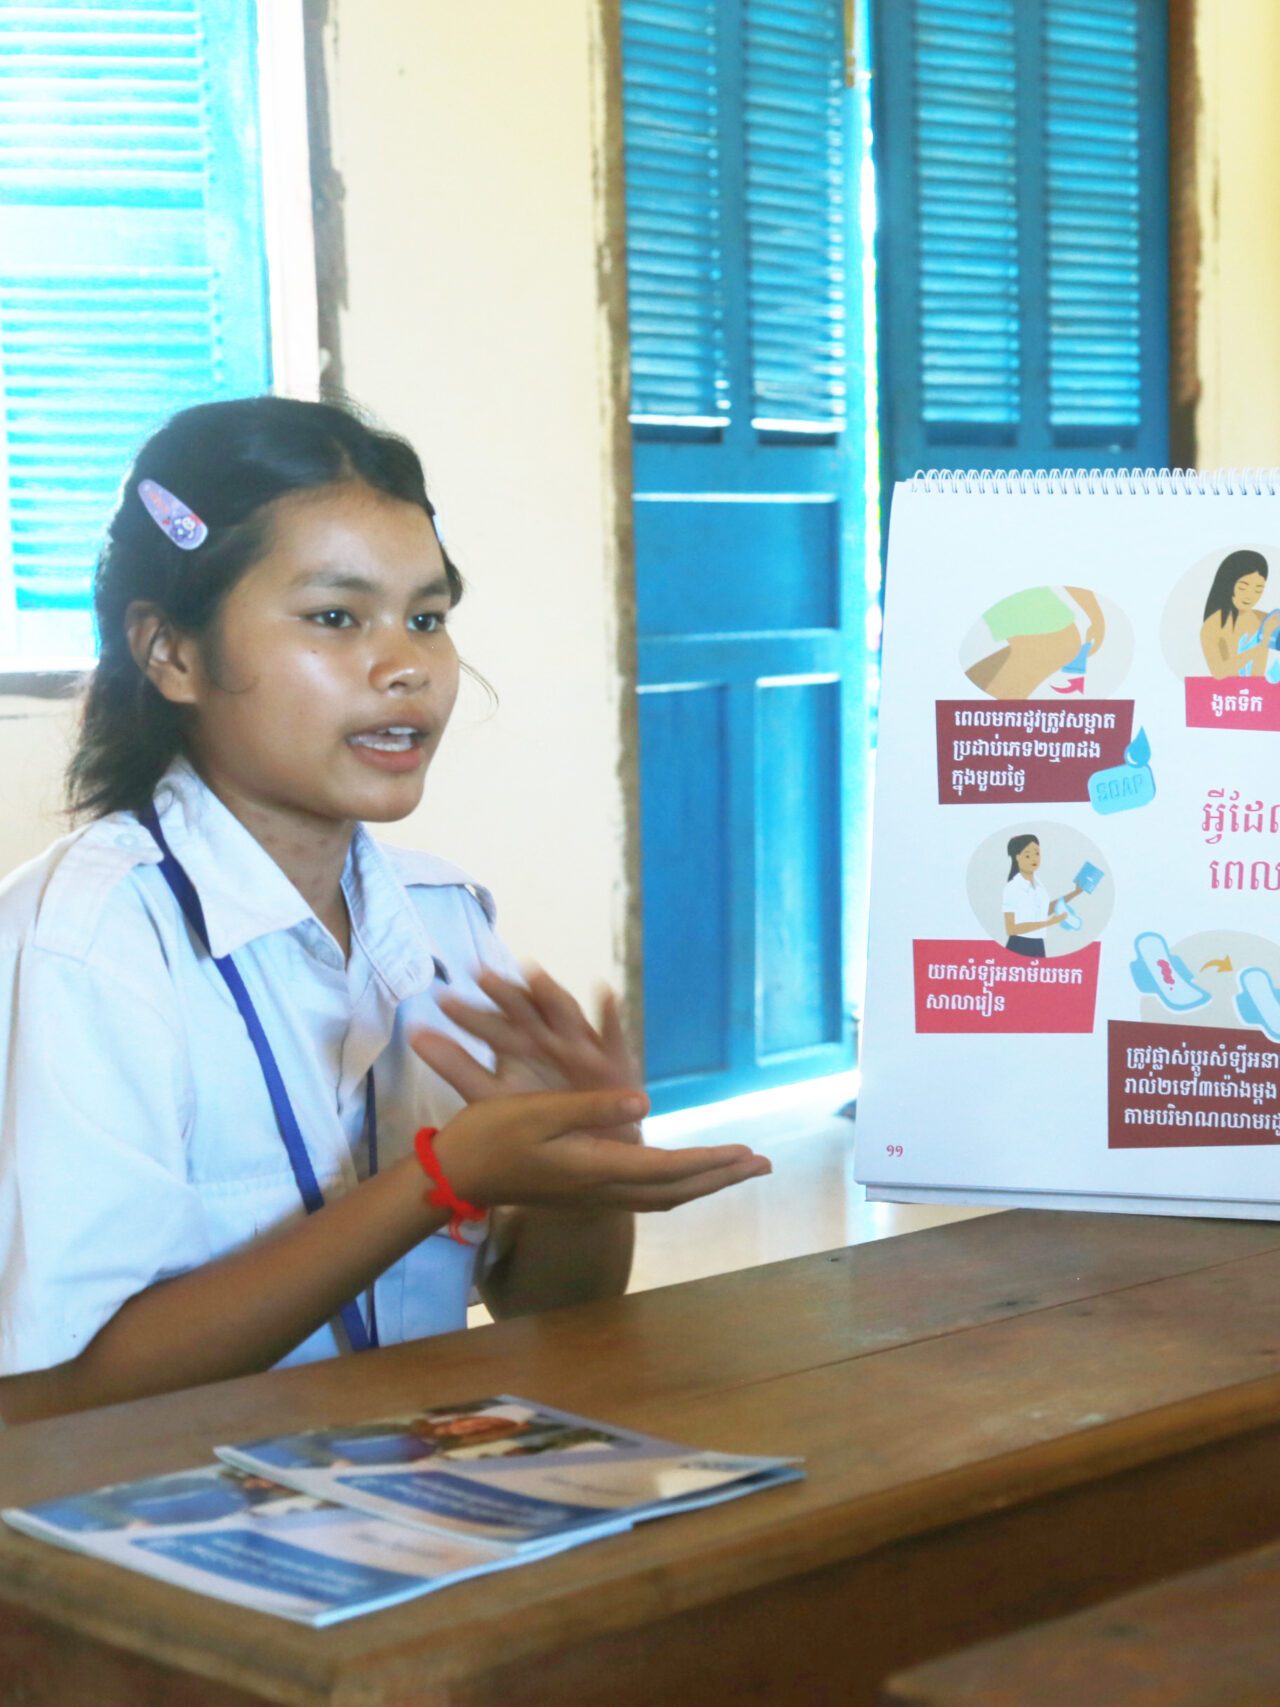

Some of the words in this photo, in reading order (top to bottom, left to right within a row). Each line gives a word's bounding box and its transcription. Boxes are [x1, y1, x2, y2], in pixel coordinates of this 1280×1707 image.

[1210, 688, 1263, 718] ងូតទឹក
[951, 763, 1026, 796] ក្នុងមួយថ្ងៃ
[926, 984, 1006, 1017] សាលារៀន
